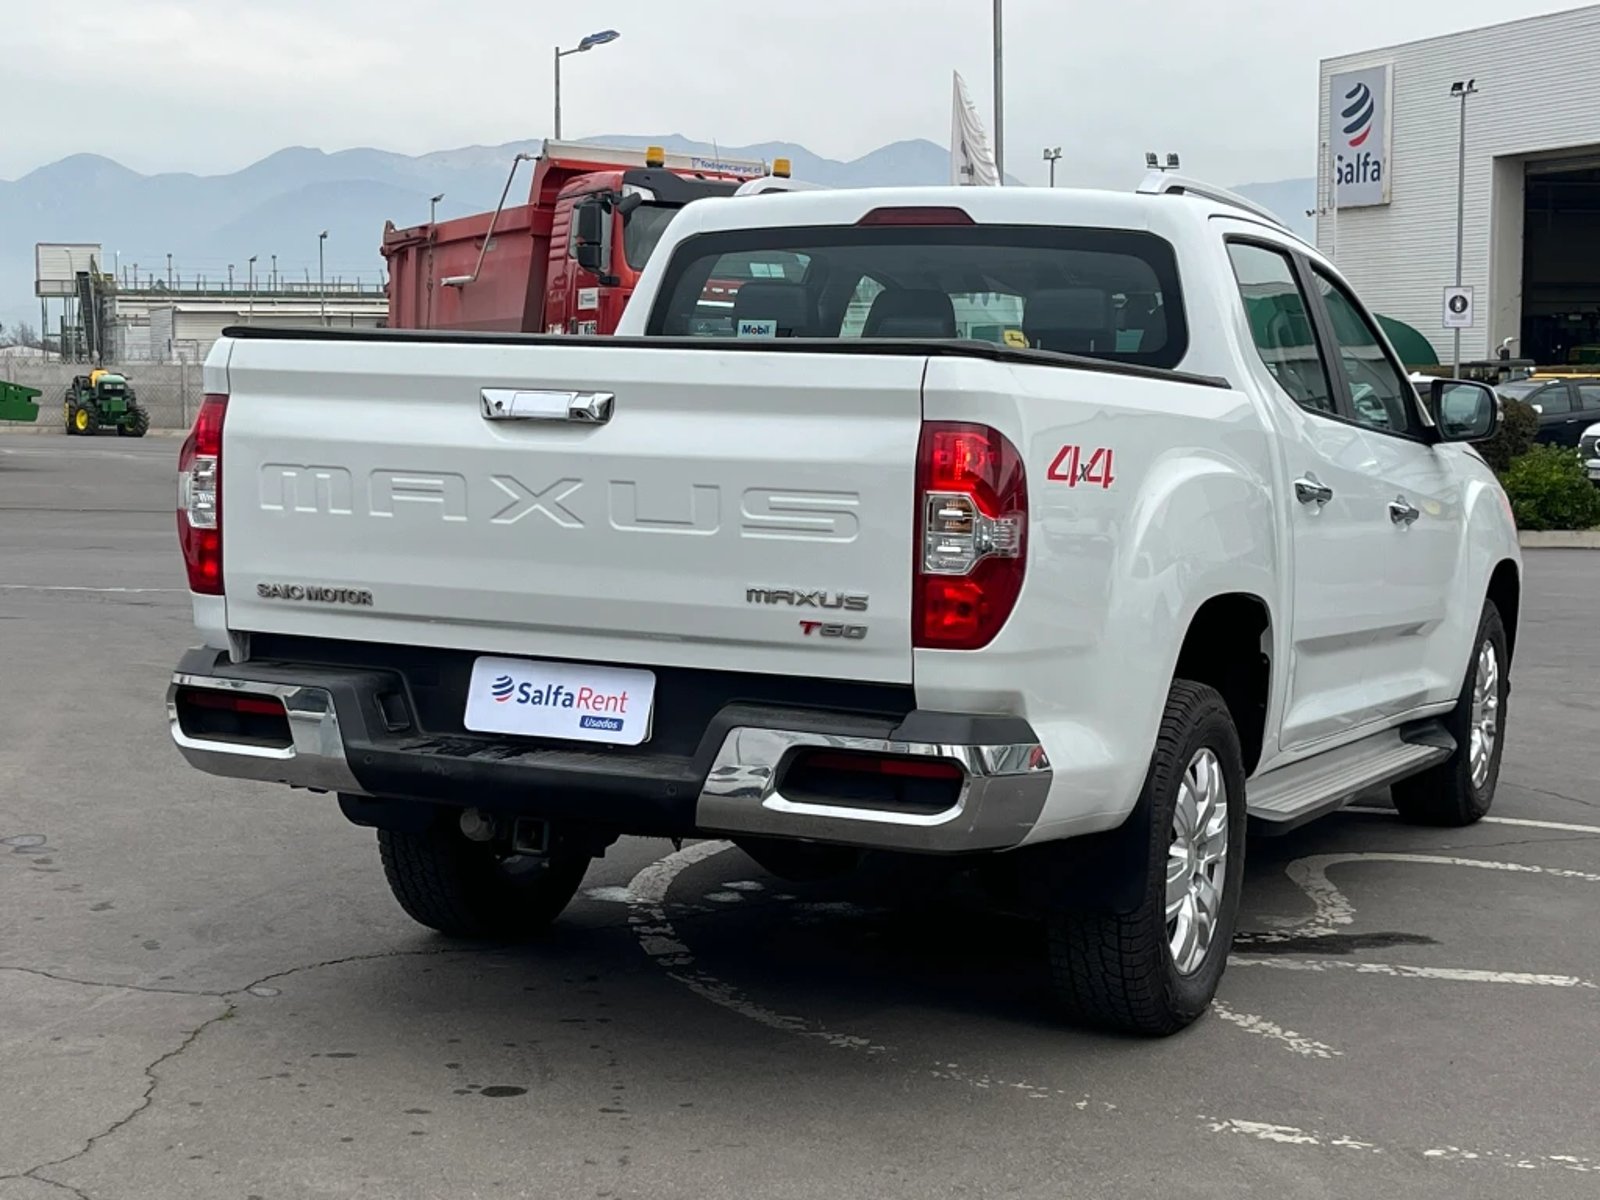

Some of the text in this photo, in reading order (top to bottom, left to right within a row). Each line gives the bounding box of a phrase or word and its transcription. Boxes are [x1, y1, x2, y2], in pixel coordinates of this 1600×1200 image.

[741, 324, 770, 335] Mobil
[1047, 444, 1115, 489] 4x4
[259, 462, 861, 544] MAXUS
[256, 583, 374, 606] SAIC MOTOR
[745, 588, 869, 612] MAXUS
[799, 620, 868, 640] T60
[584, 717, 619, 730] Usados
